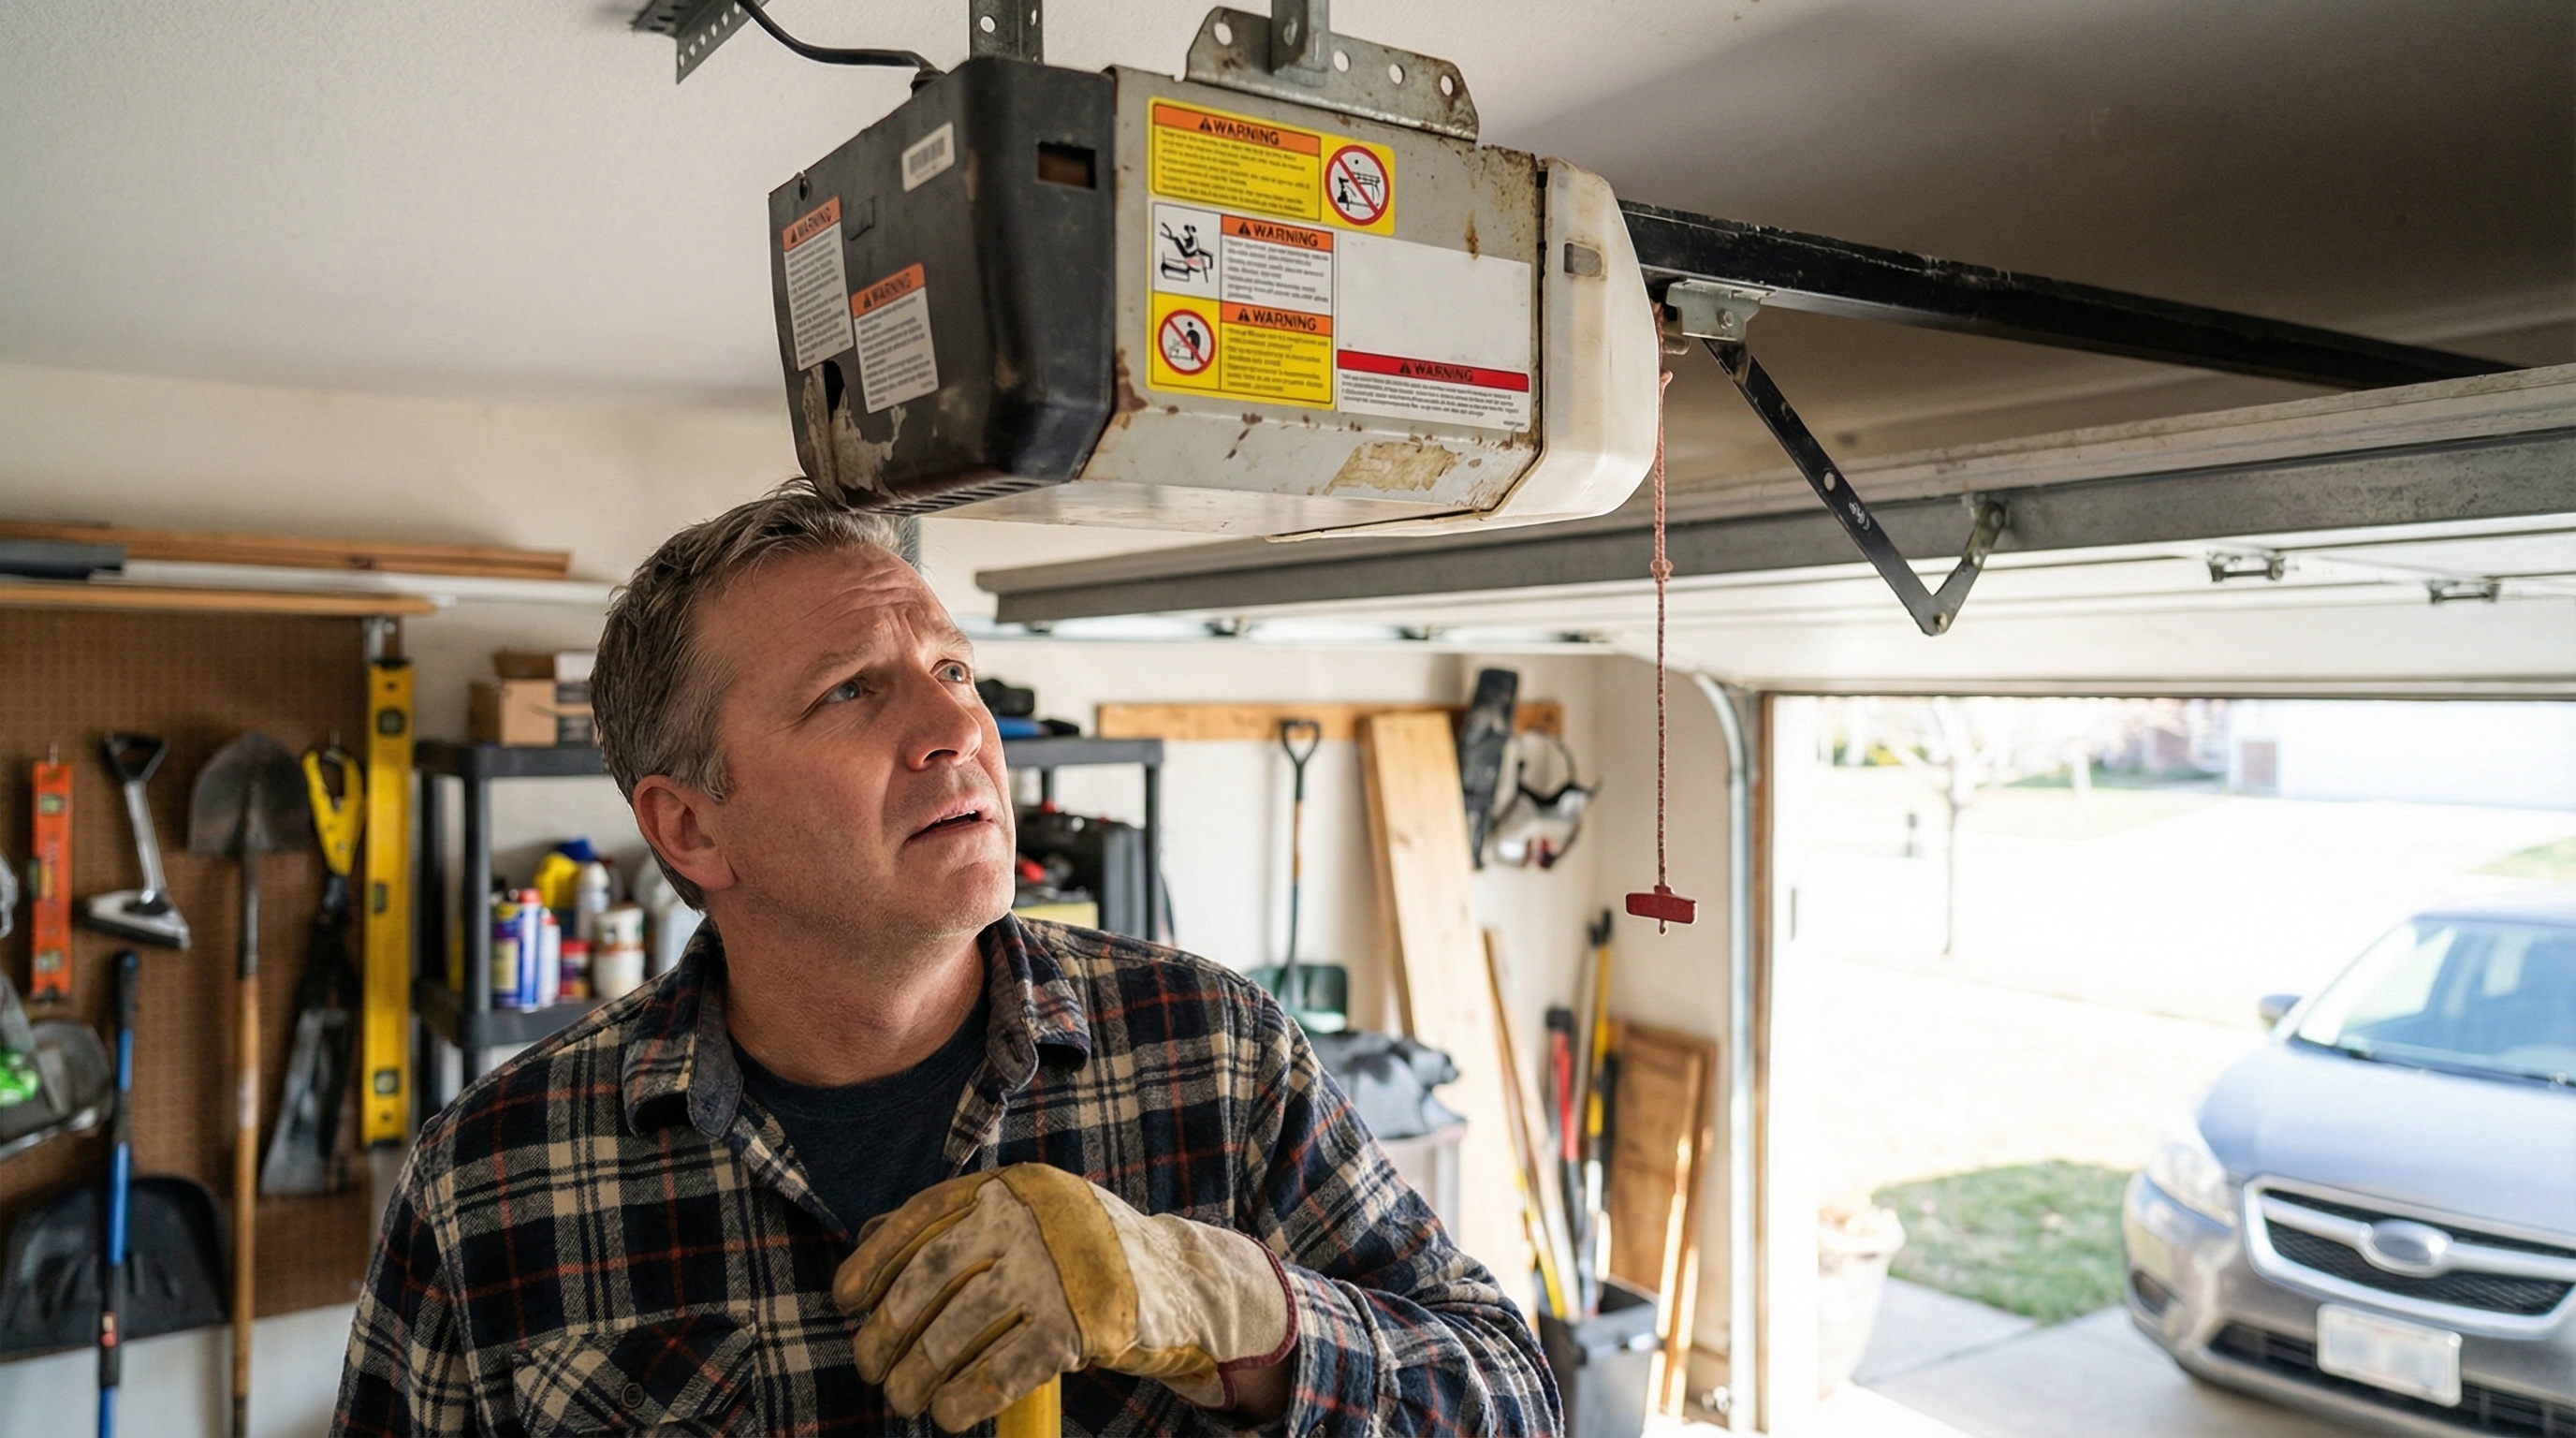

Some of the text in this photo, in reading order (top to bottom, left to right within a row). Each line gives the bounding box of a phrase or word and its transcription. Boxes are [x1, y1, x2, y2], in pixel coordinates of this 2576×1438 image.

[1213, 119, 1280, 146] WARNING
[1253, 223, 1318, 247] WARNING
[1252, 311, 1317, 331] WARNING
[1413, 362, 1474, 382] WARNING
